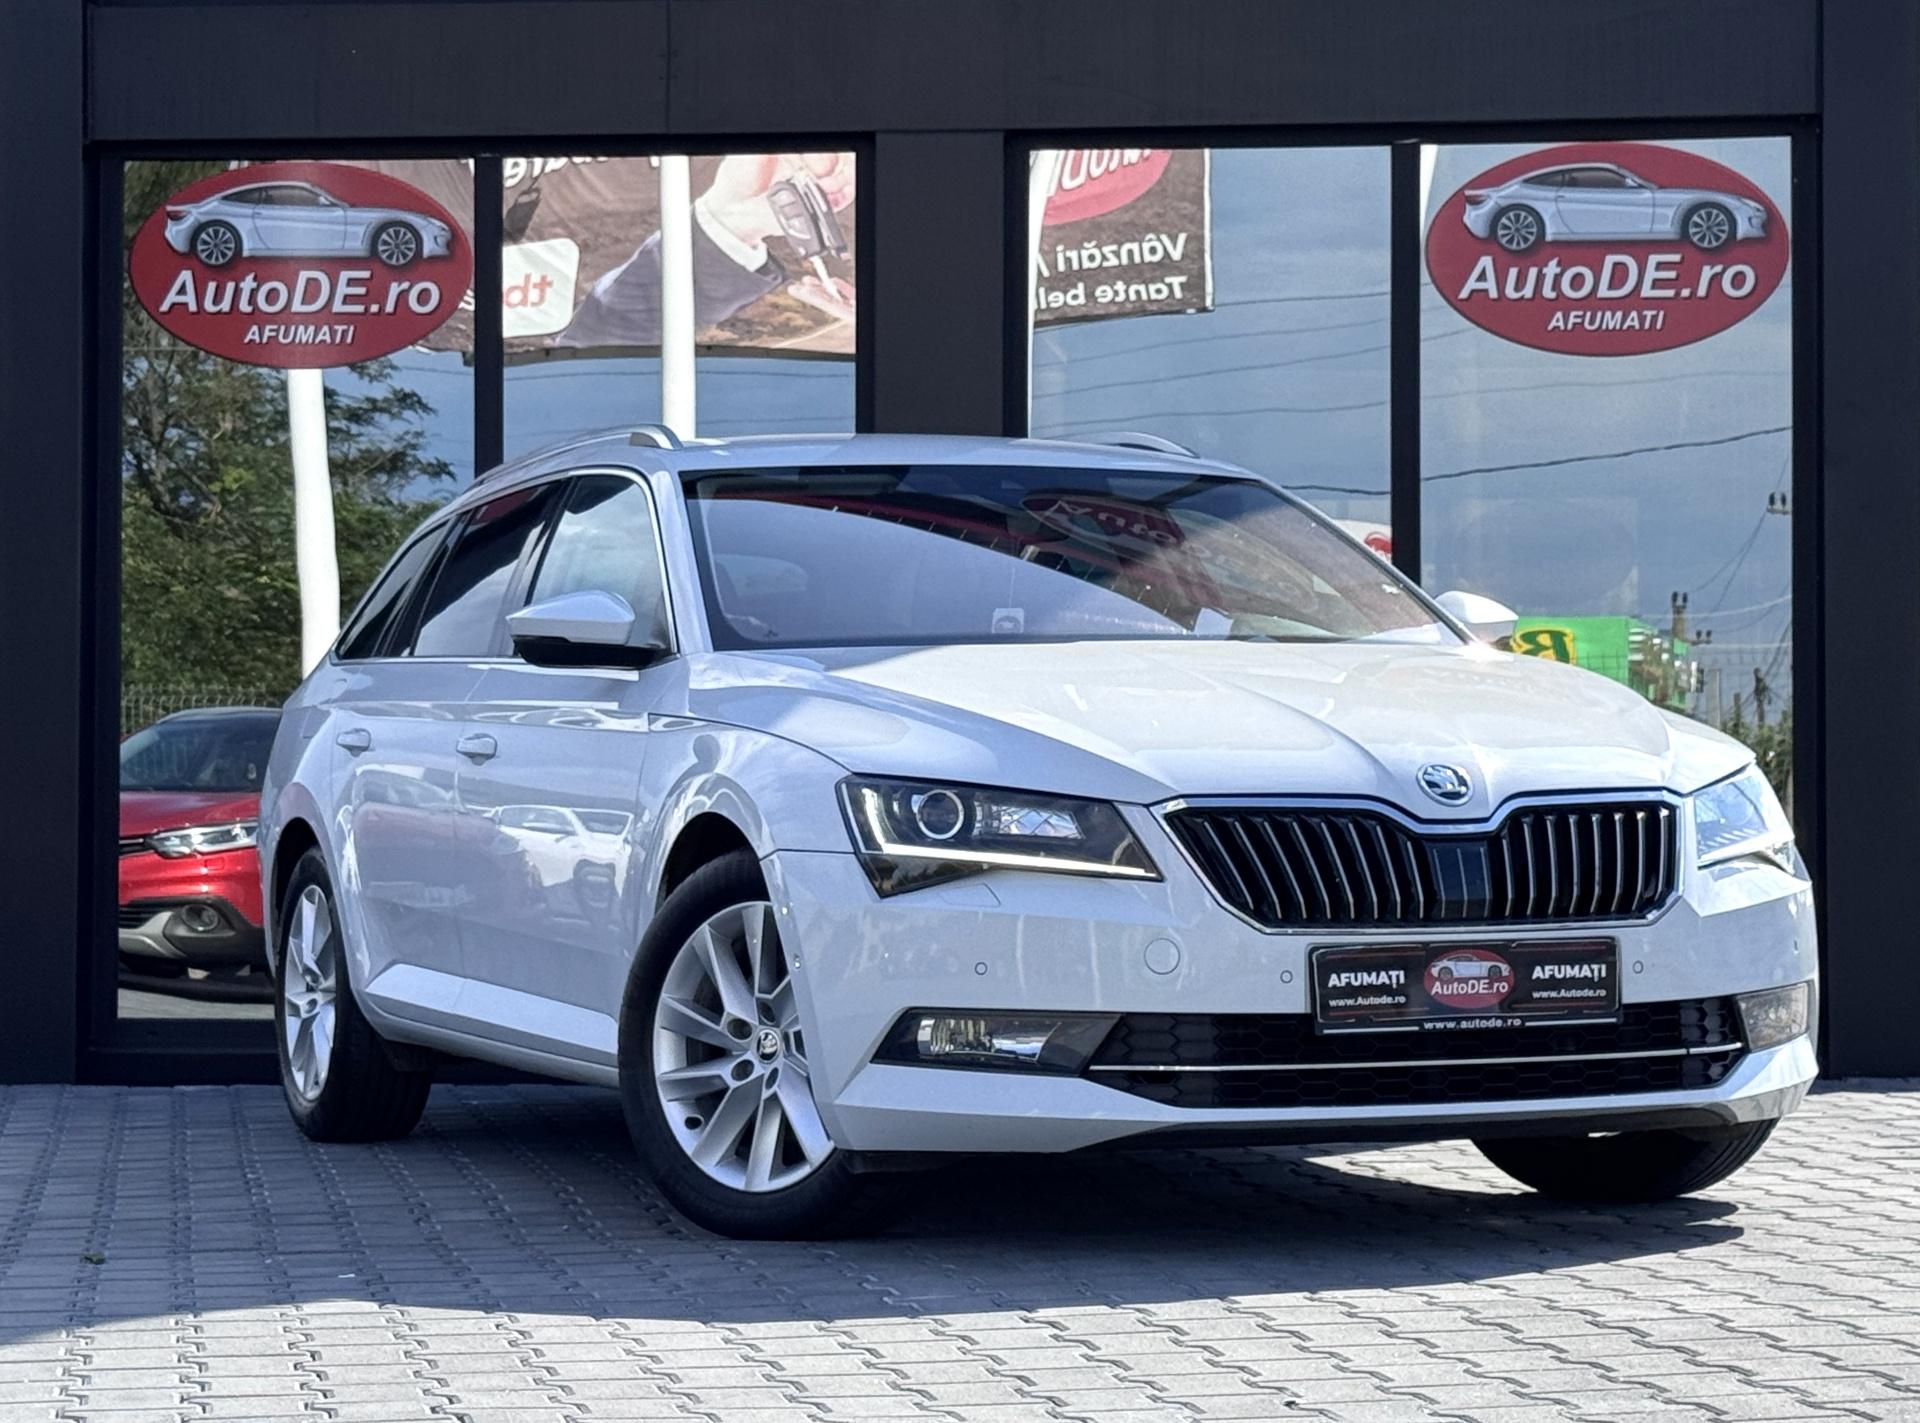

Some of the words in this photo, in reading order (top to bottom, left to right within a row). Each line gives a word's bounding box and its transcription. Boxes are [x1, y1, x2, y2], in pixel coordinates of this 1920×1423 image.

[1458, 254, 1756, 299] AutoDE.ro
[159, 270, 441, 314] AutoDE.ro
[1547, 310, 1664, 331] AFUMATI
[244, 325, 355, 345] AFUMATI
[1430, 979, 1509, 996] AutoDE.ro
